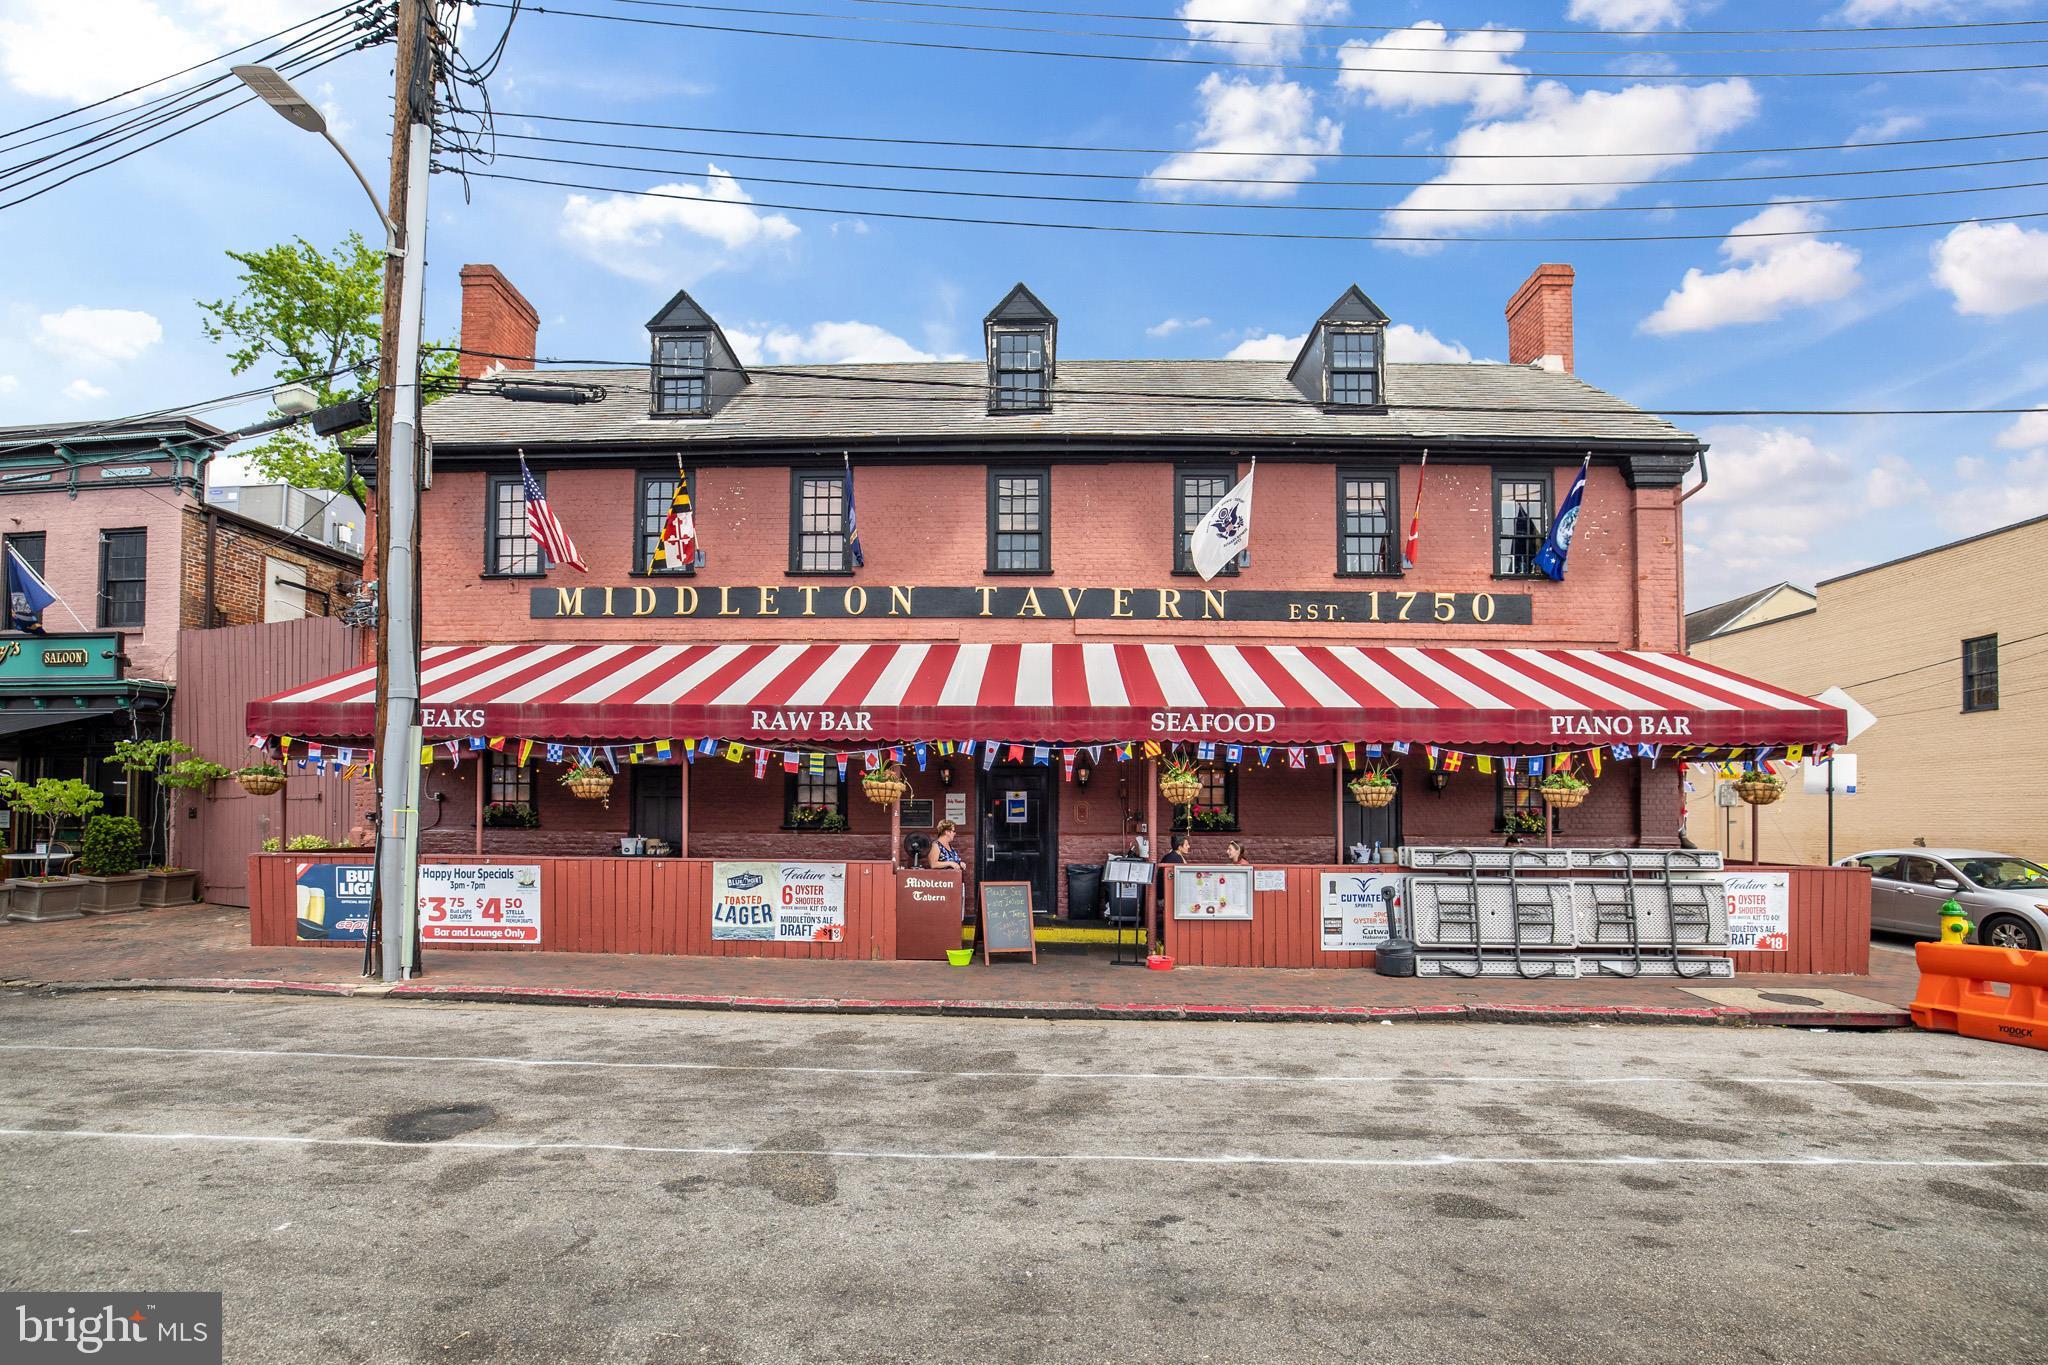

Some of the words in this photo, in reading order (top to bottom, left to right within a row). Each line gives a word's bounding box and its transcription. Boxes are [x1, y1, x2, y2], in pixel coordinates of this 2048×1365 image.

[555, 586, 917, 616] MIDDLETON
[975, 586, 1229, 619] TAVERN
[1288, 603, 1346, 621] EST.
[1368, 591, 1496, 622] 1750
[44, 652, 82, 663] SALOON
[420, 709, 485, 728] EAKS
[751, 710, 813, 732] RAW
[820, 711, 874, 732] BAR
[1150, 712, 1276, 733] SEAFOOD
[1550, 715, 1633, 736] PIANO
[1639, 716, 1692, 736] BAR
[422, 868, 452, 881] Happy
[454, 868, 475, 879] Hour
[477, 868, 514, 881] Specials
[781, 867, 826, 882] Feature
[450, 881, 466, 890] 3pm
[471, 881, 486, 891] 7pm
[904, 877, 954, 888] Middleton
[1725, 878, 1768, 891] Feature
[339, 883, 373, 895] LIGH
[782, 885, 793, 905] 6
[795, 885, 824, 895] OYSTER
[724, 896, 762, 904] TOASTED
[795, 897, 825, 905] SHOOTERS
[912, 890, 946, 901] Tavern
[1738, 895, 1766, 905] OYSTER
[714, 903, 773, 925] LAGER
[780, 916, 821, 924] MIDDLETON'S
[434, 928, 450, 936] Bar
[452, 929, 469, 937] and
[470, 929, 503, 938] Lounge
[505, 929, 526, 938] Only
[780, 924, 813, 936] DRAFT
[1730, 925, 1764, 933] IDDLETON'S
[1731, 934, 1756, 945] RAFT
[1766, 937, 1783, 949] $18
[1998, 1025, 2033, 1037] YODOCK
